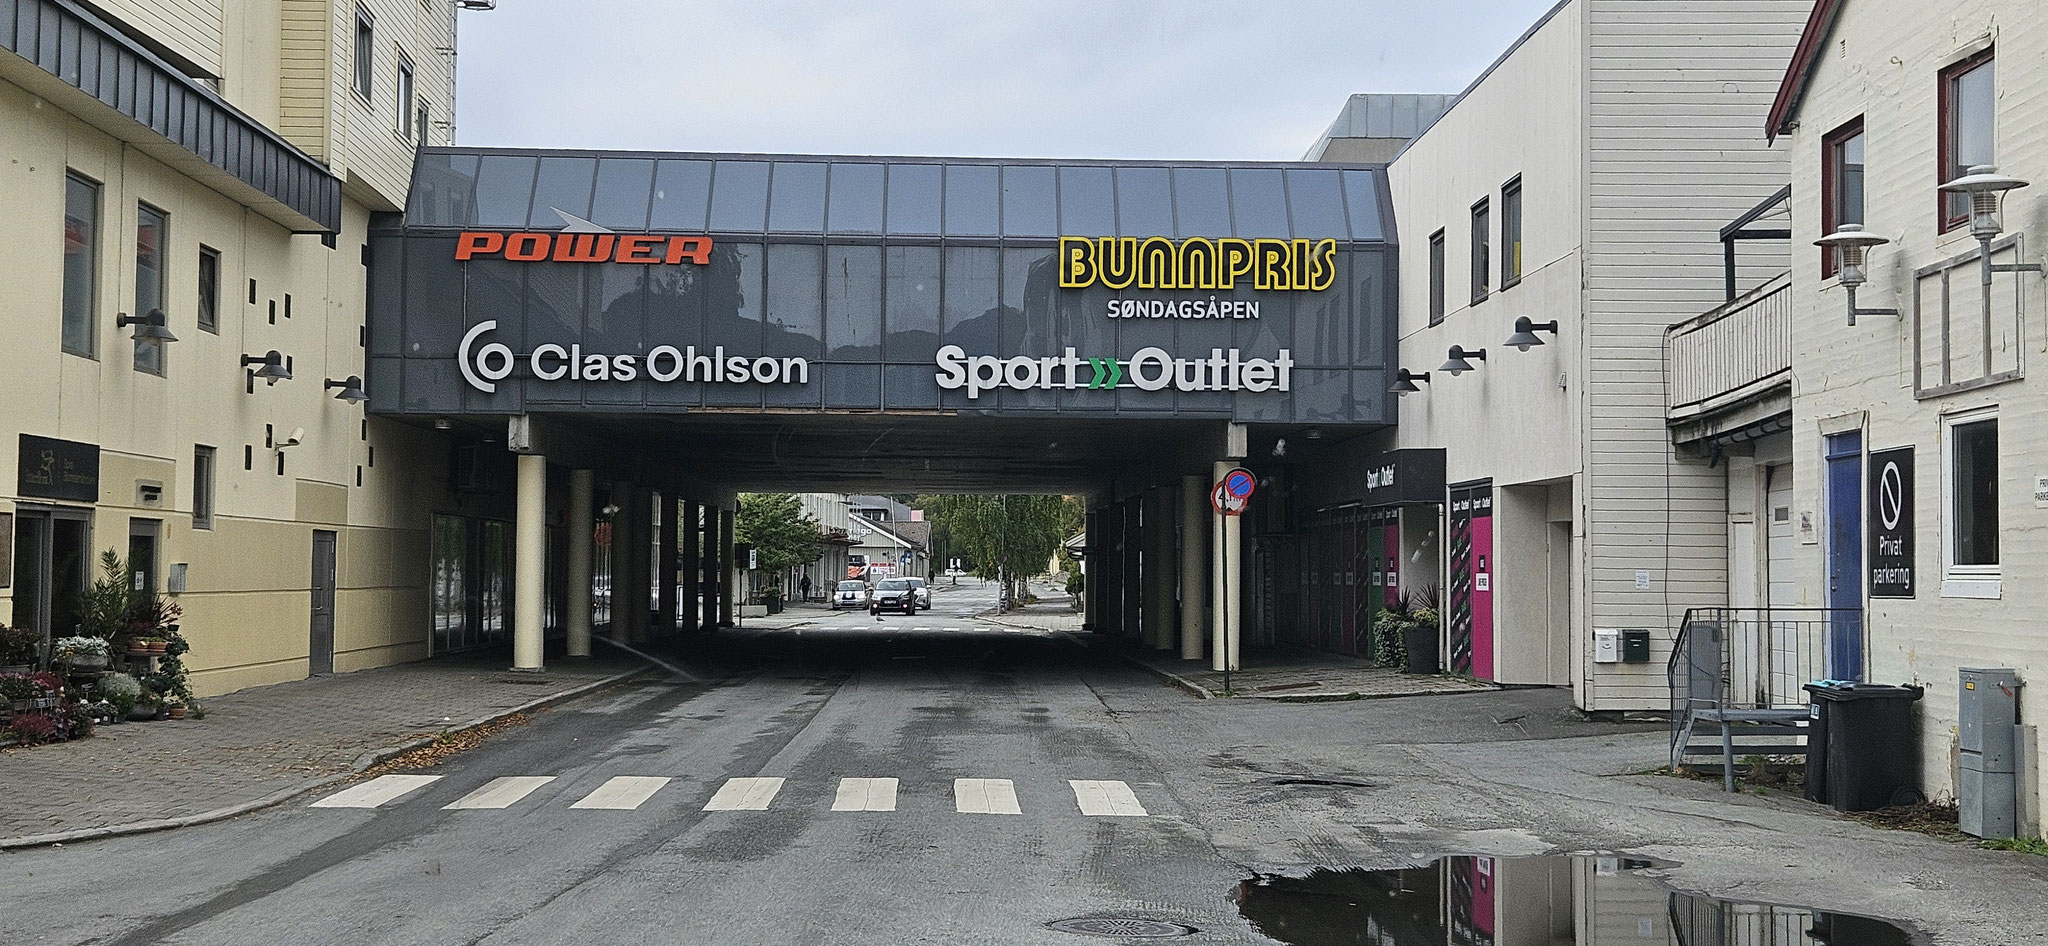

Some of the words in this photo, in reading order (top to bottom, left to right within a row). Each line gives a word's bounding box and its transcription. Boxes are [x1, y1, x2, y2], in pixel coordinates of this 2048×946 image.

[454, 232, 714, 265] POWER
[1058, 236, 1337, 291] BUNNPRIS
[1107, 296, 1259, 320] SØNDAGSÅPEN
[530, 342, 638, 382] Clas
[646, 344, 809, 384] Ohlson
[935, 345, 1080, 399] Sport
[1128, 347, 1294, 392] Outlet
[1879, 535, 1903, 556] Privat
[1873, 563, 1910, 590] parkering
